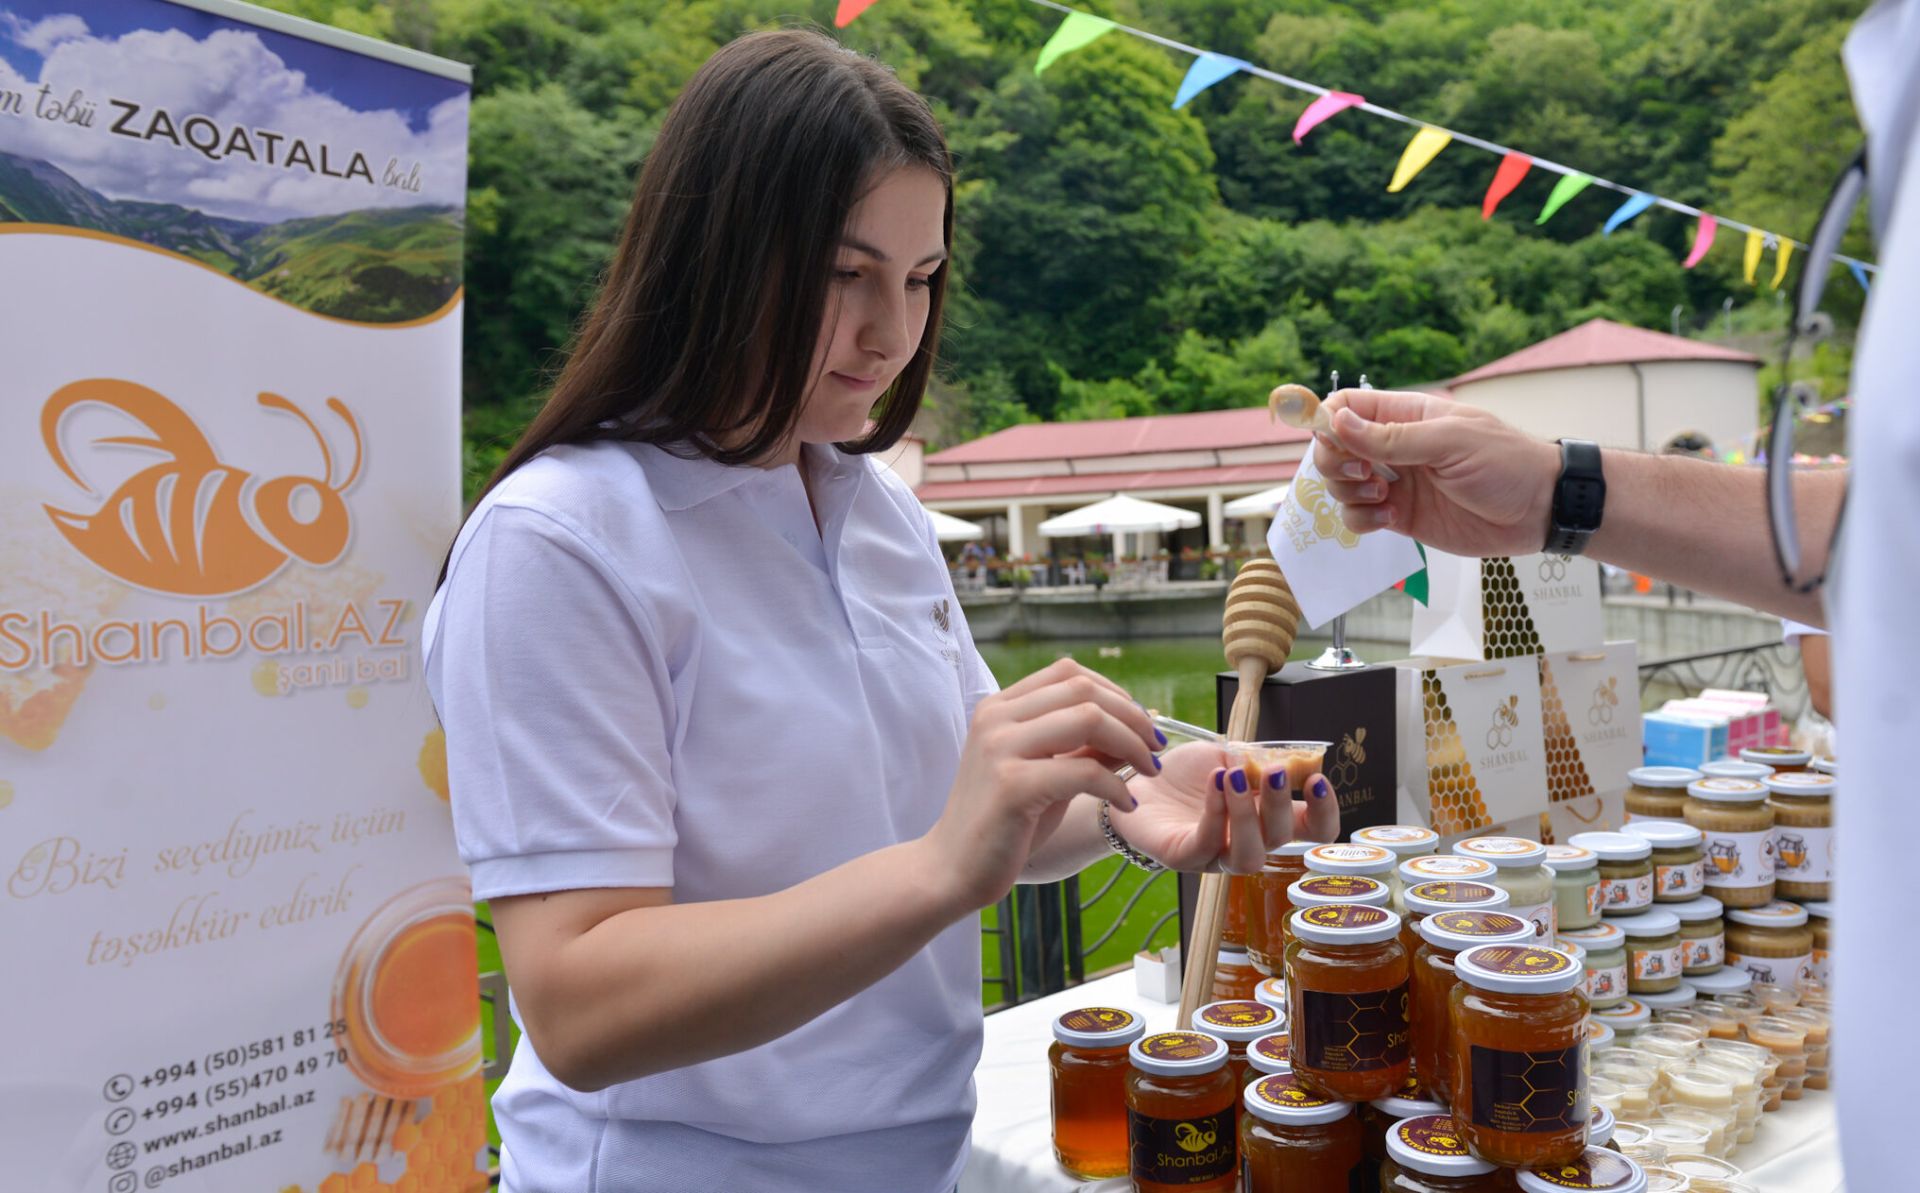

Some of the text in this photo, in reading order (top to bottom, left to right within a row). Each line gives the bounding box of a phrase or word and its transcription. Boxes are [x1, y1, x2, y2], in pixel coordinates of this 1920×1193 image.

[109, 99, 374, 184] ZAQATALA
[1533, 585, 1583, 600] SHANBAL
[0, 600, 405, 669] Shanbal.AZ
[357, 653, 405, 680] bal
[1480, 750, 1528, 768] SHANBAL
[8, 836, 128, 899] Bizi
[330, 810, 406, 847] üçün
[86, 864, 364, 968] təşəkkür edirik
[140, 1019, 348, 1089] +994 (50)581 81 25
[141, 1048, 348, 1121] +994 (55)470 49 70
[144, 1089, 316, 1154] www.shanbal.az
[144, 1128, 284, 1190] @shanbal.az
